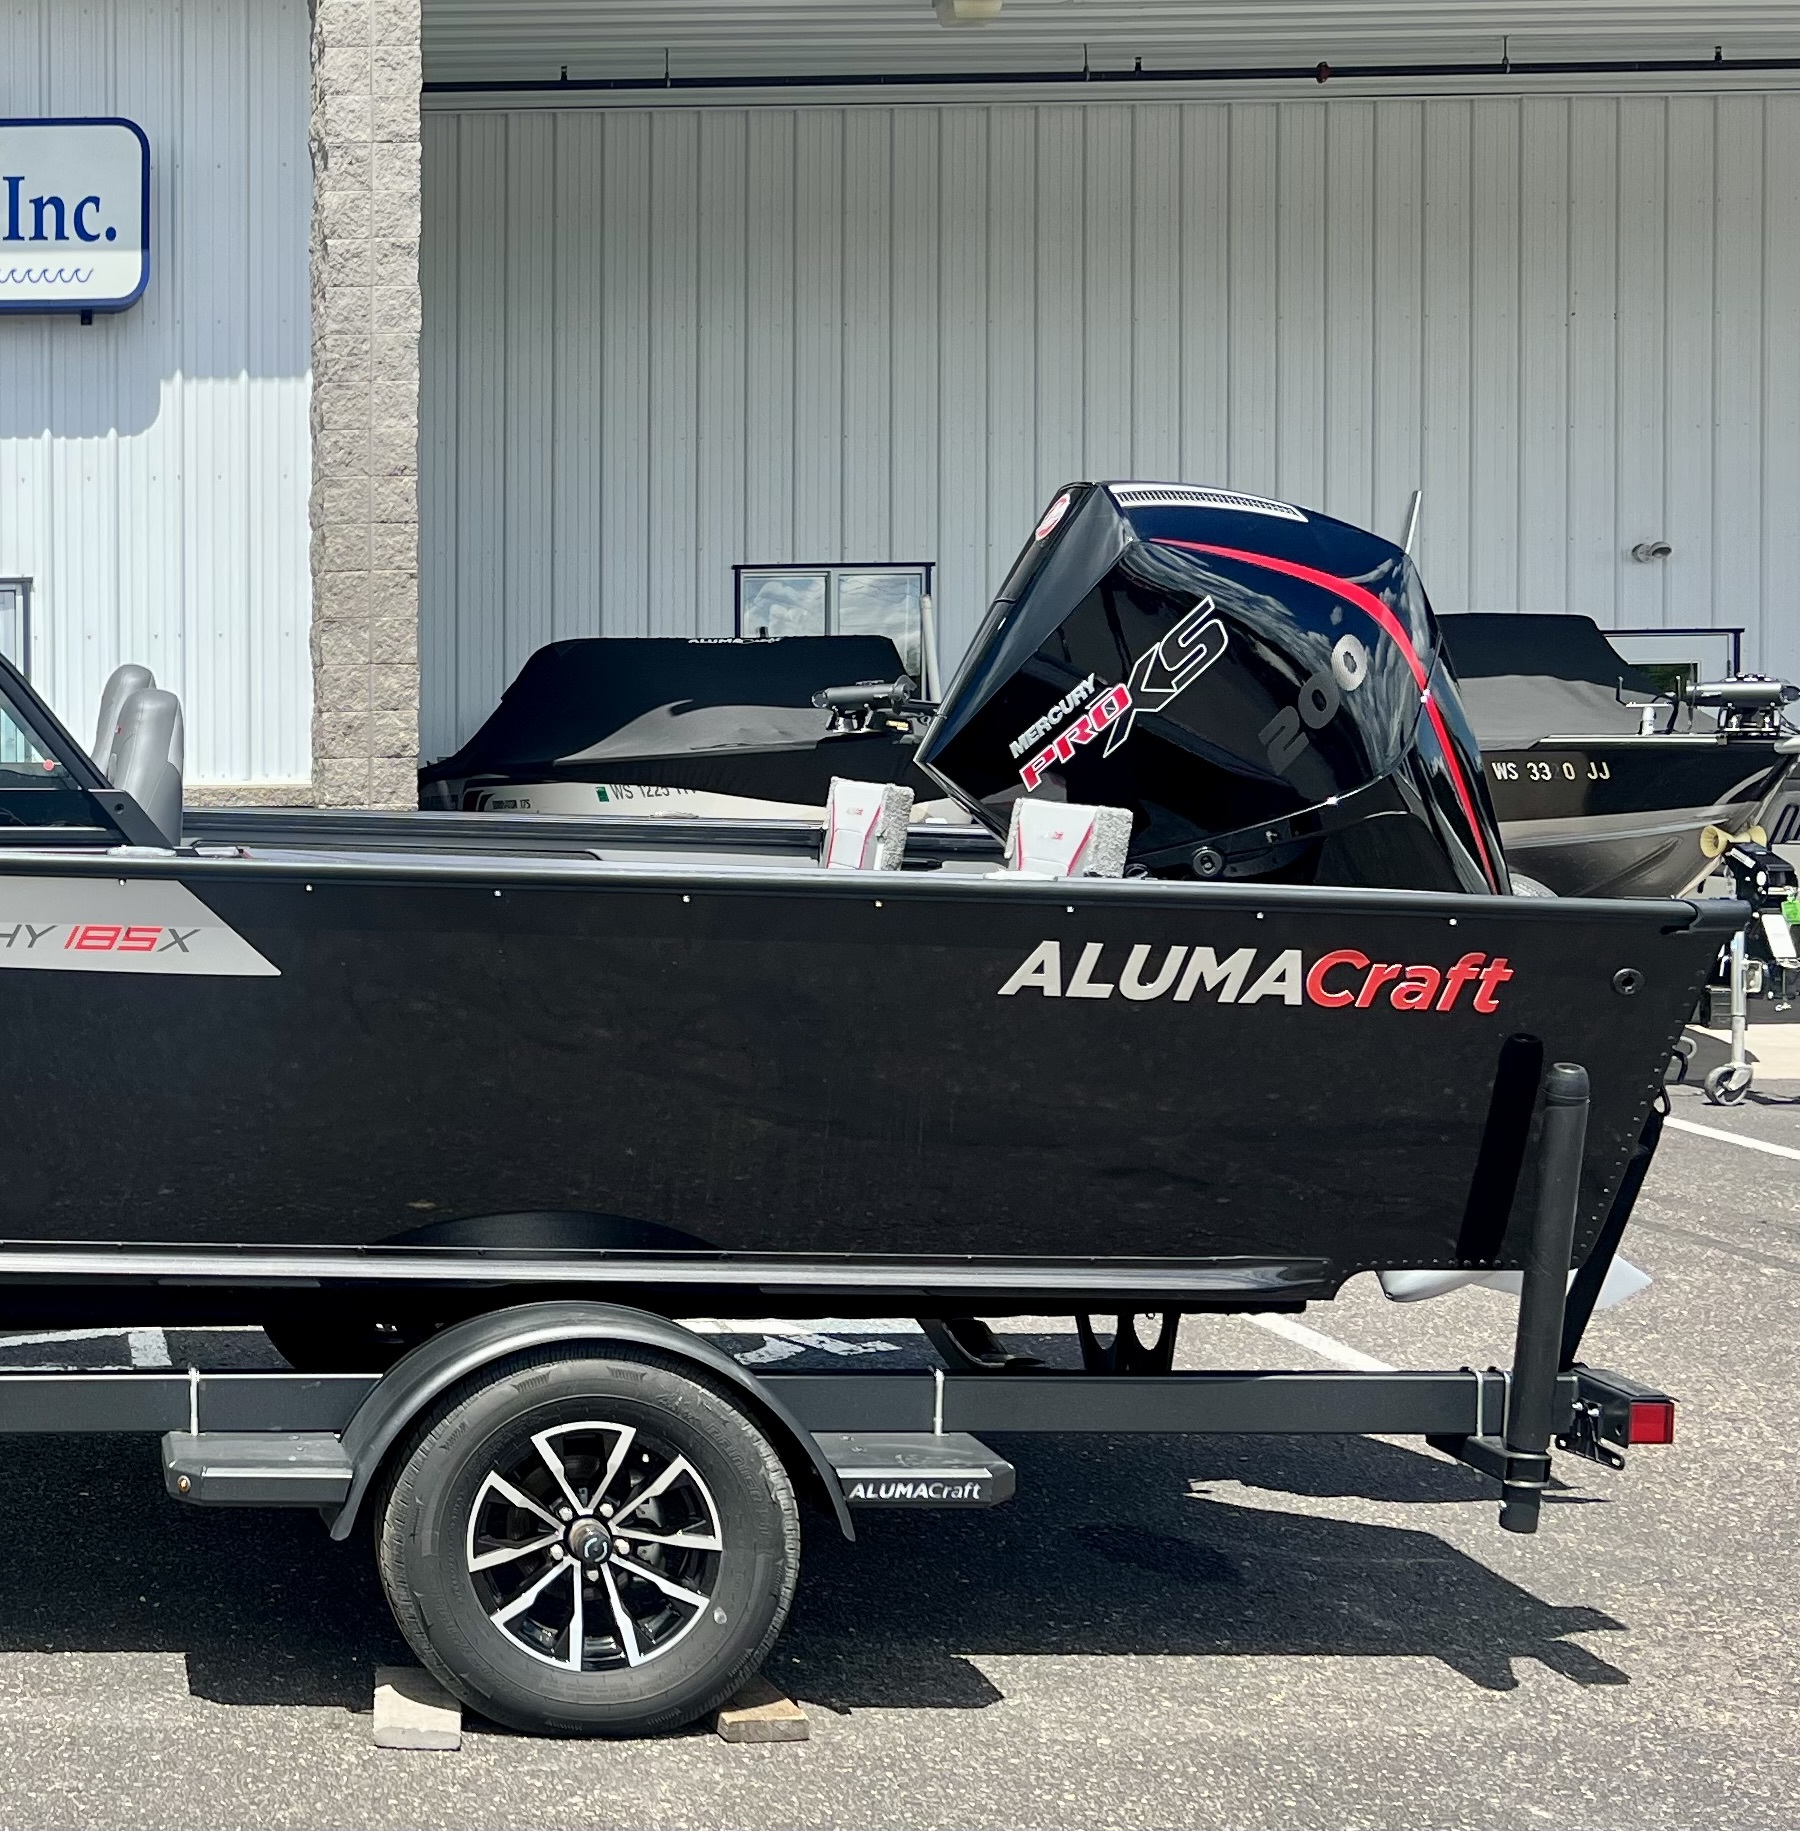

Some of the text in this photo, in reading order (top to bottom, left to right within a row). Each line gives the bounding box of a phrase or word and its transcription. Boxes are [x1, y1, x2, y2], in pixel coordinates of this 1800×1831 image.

[2, 176, 118, 243] Inc.
[1009, 672, 1097, 759] MERCURY
[1258, 633, 1368, 776] 200
[609, 784, 634, 799] WS
[1491, 761, 1519, 780] WS
[1587, 761, 1610, 780] JJ
[64, 925, 202, 953] 185X
[997, 939, 1514, 1013] ALUMACraft
[849, 1482, 982, 1500] ALUMACraft
